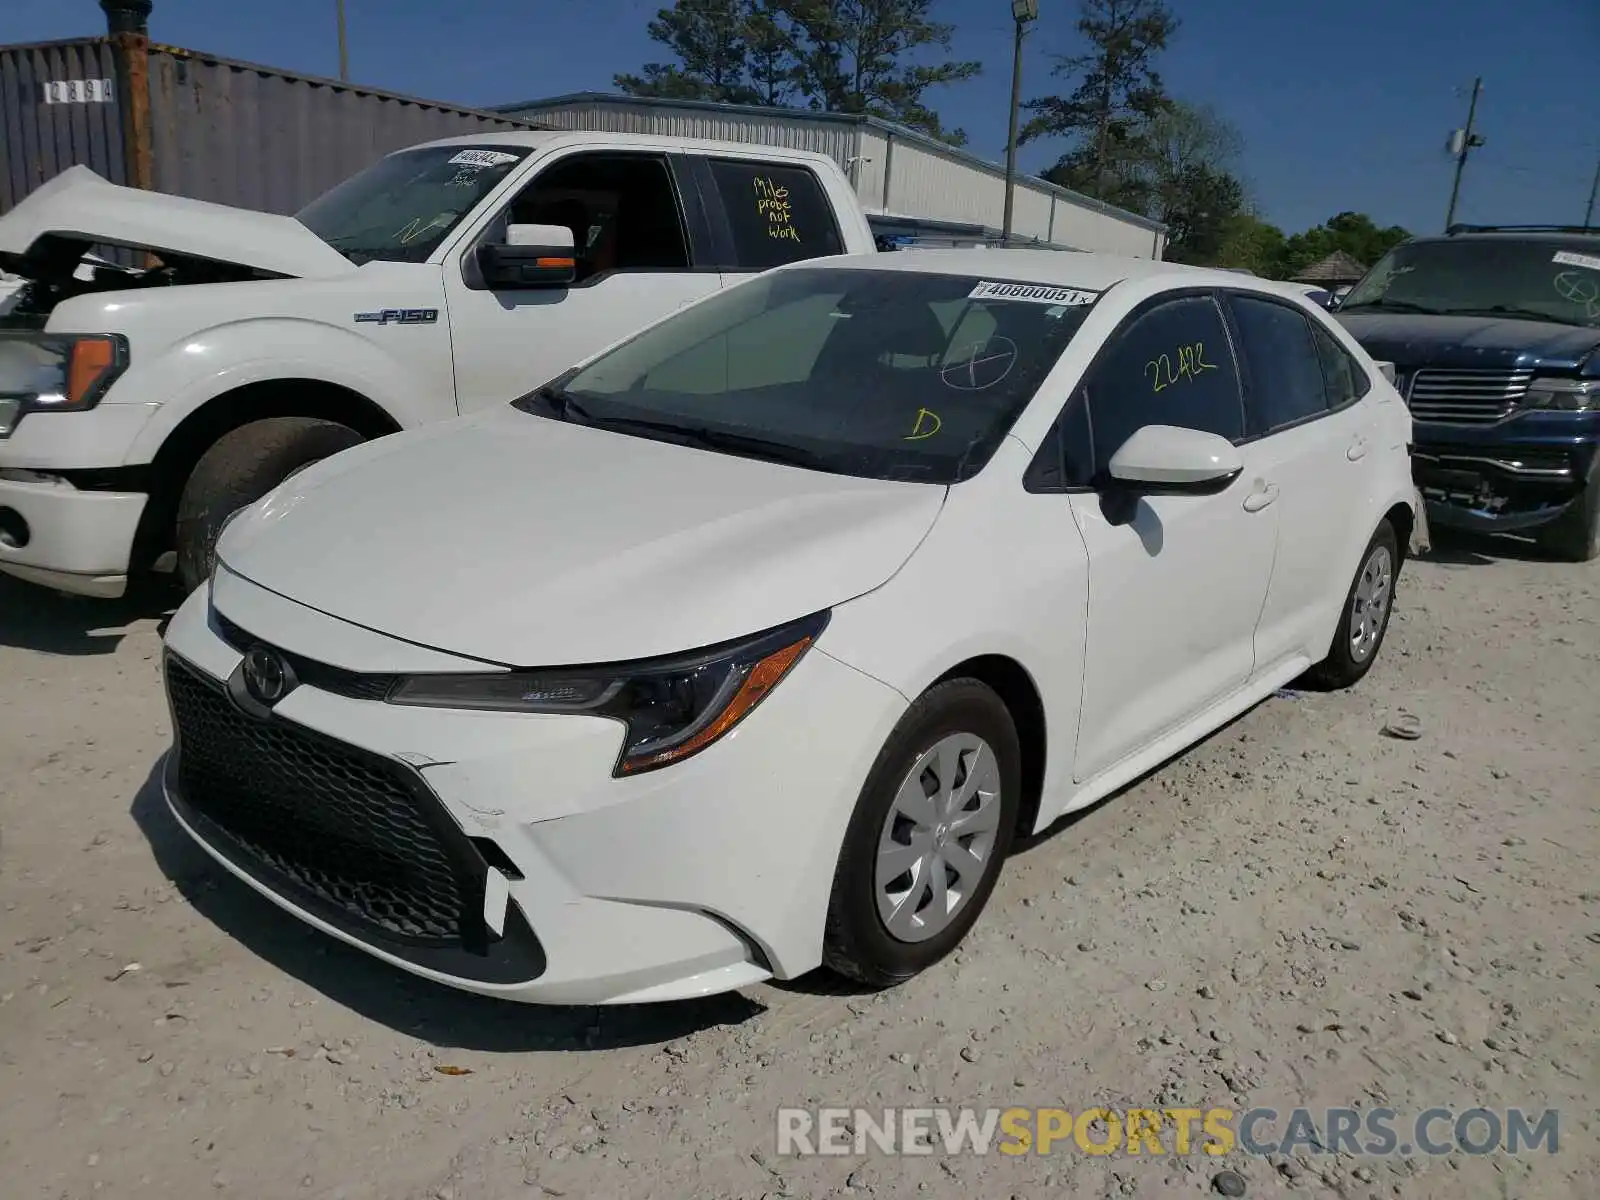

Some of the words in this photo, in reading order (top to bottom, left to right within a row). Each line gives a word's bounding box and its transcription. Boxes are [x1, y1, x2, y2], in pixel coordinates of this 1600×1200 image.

[758, 196, 791, 214] probe
[769, 210, 791, 223] not
[987, 283, 1081, 302] 40800051
[379, 309, 439, 325] F-150
[903, 407, 942, 440] D
